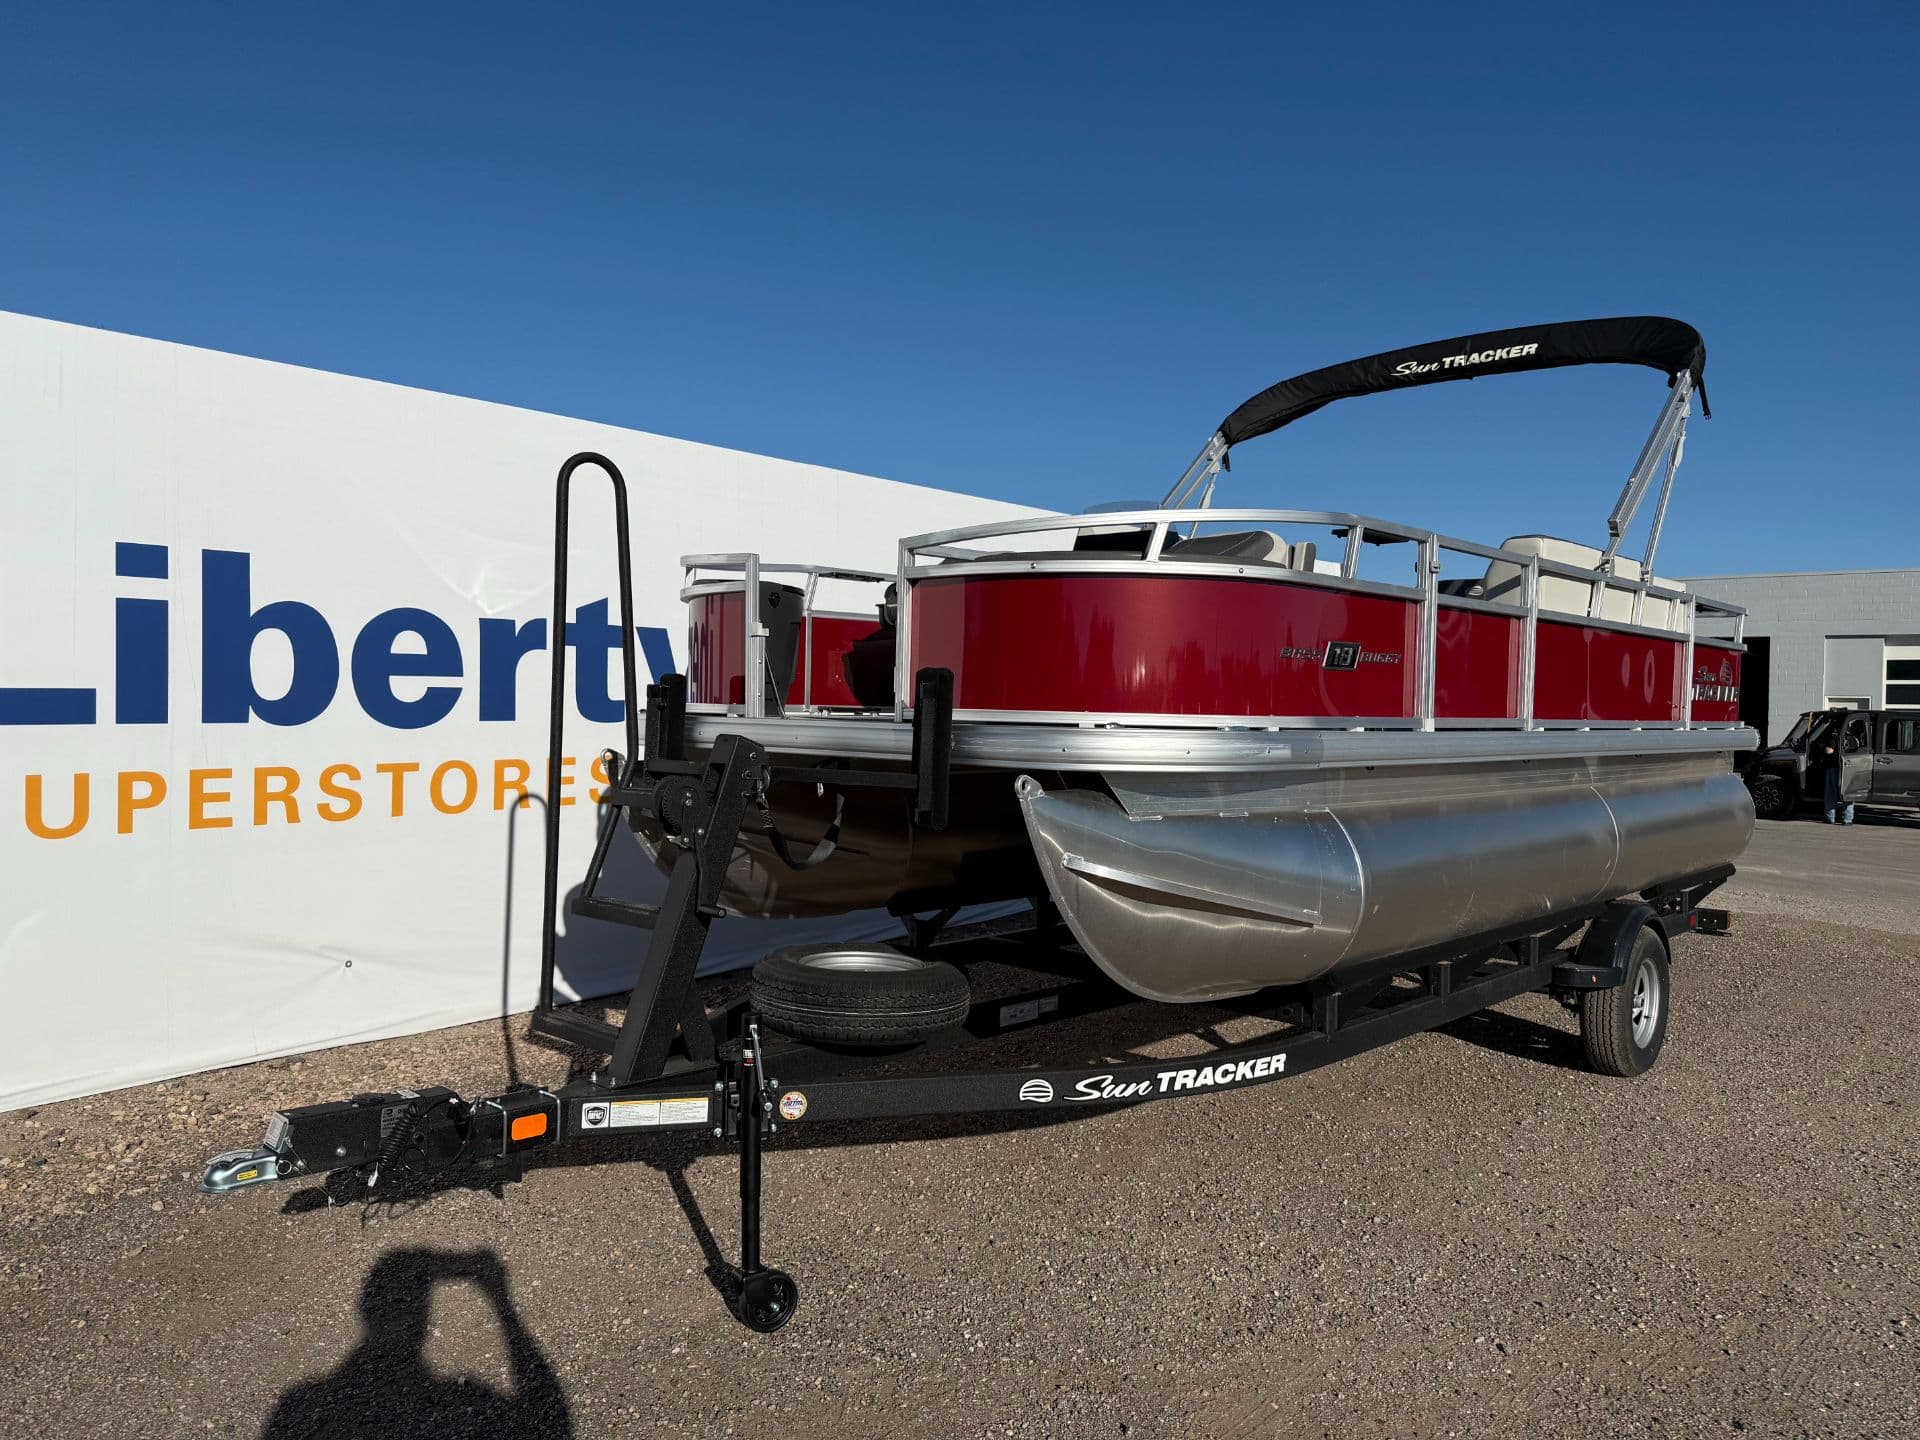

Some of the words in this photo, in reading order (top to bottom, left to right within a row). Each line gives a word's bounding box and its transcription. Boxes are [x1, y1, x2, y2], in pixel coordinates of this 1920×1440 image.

[1390, 360, 1441, 376] Sun
[1441, 343, 1539, 369] TRACKER
[1063, 1074, 1153, 1101] Sun
[1156, 1053, 1287, 1093] TRACKER
